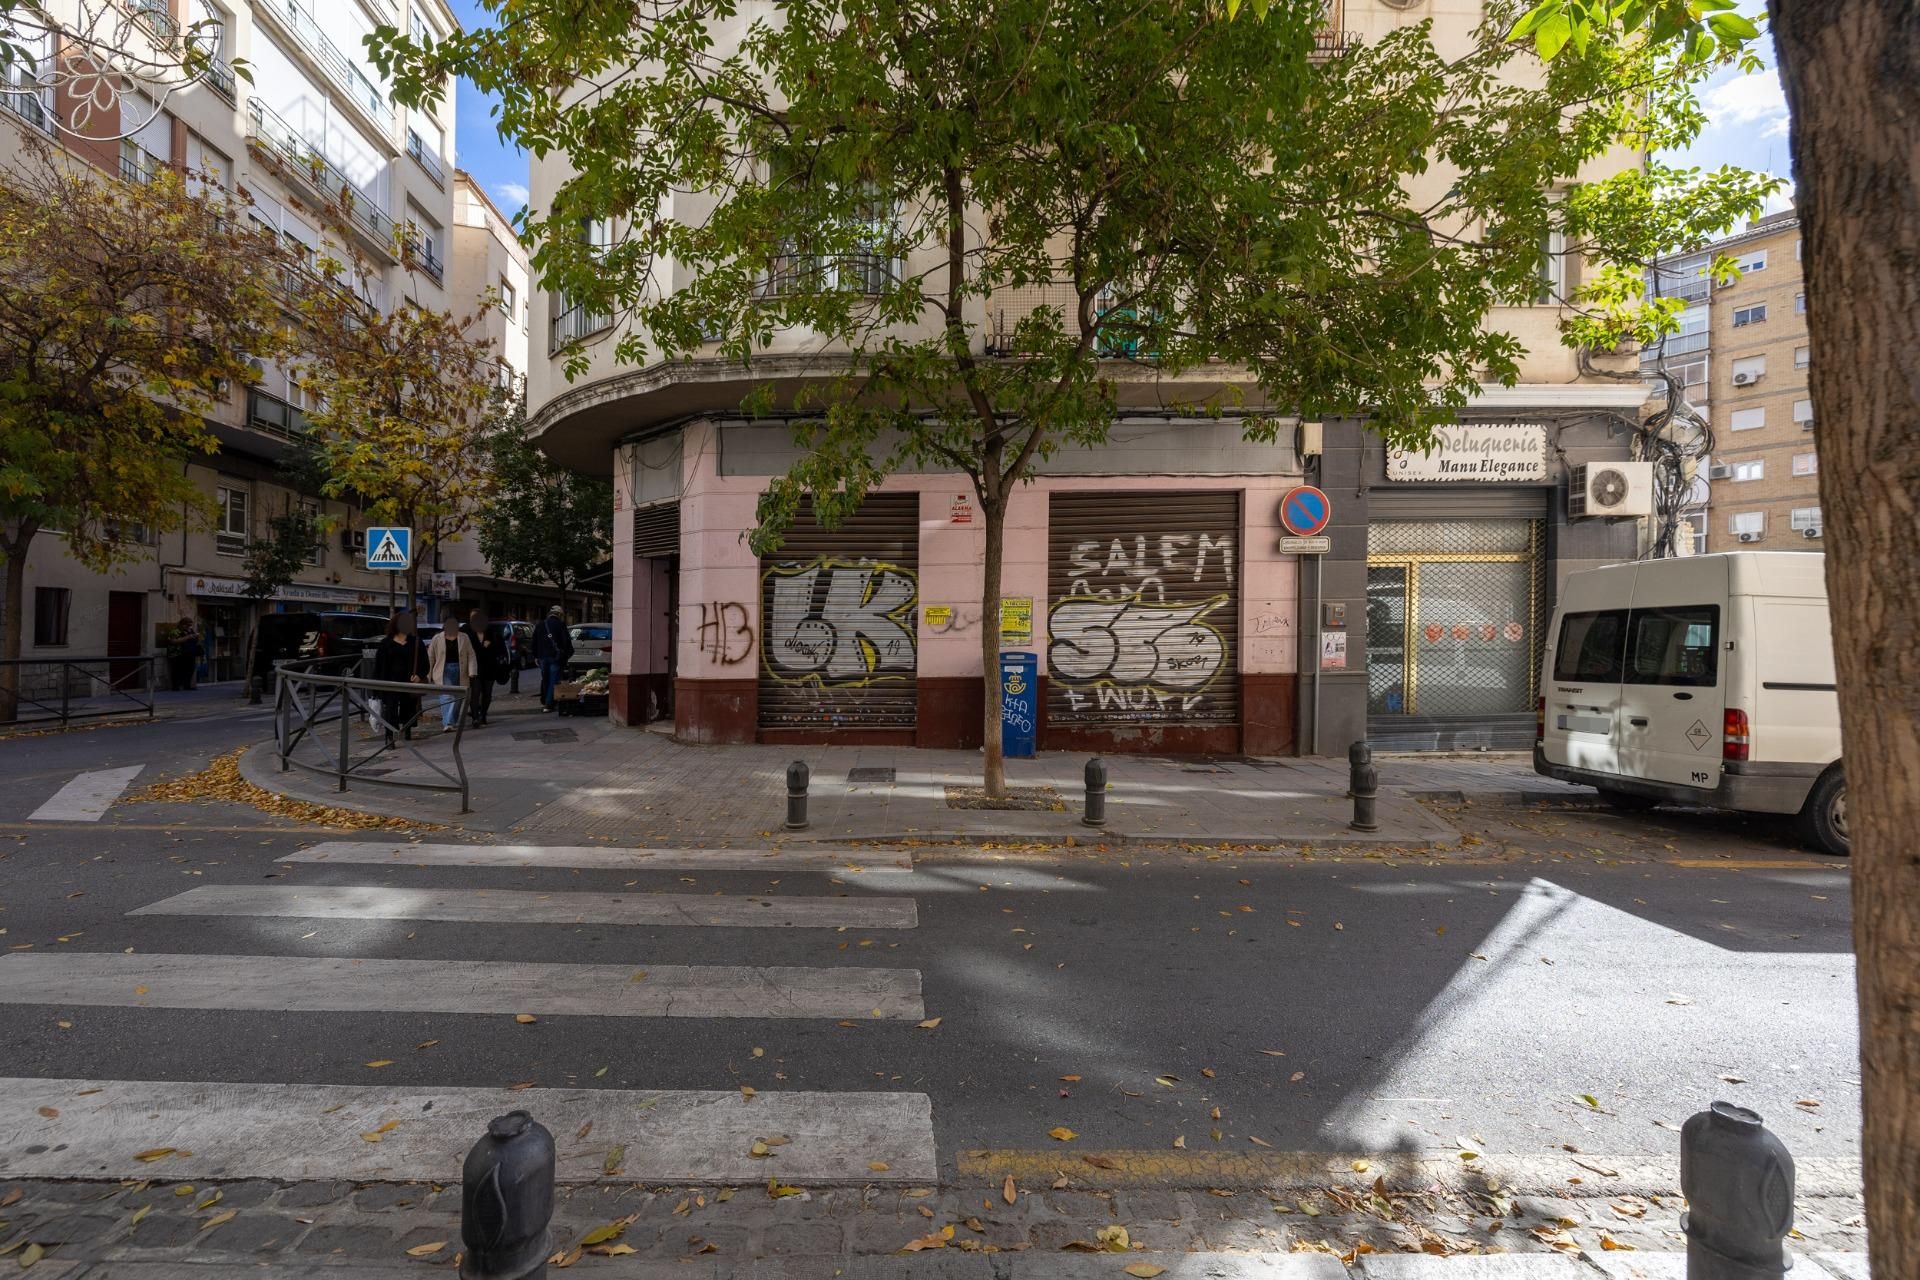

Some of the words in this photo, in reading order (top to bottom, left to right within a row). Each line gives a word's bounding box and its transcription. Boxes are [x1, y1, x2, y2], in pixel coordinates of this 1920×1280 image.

[1438, 459, 1477, 473] Manu
[1479, 459, 1539, 476] Elegance
[1067, 532, 1235, 588] SALEM
[1691, 771, 1709, 783] MP
